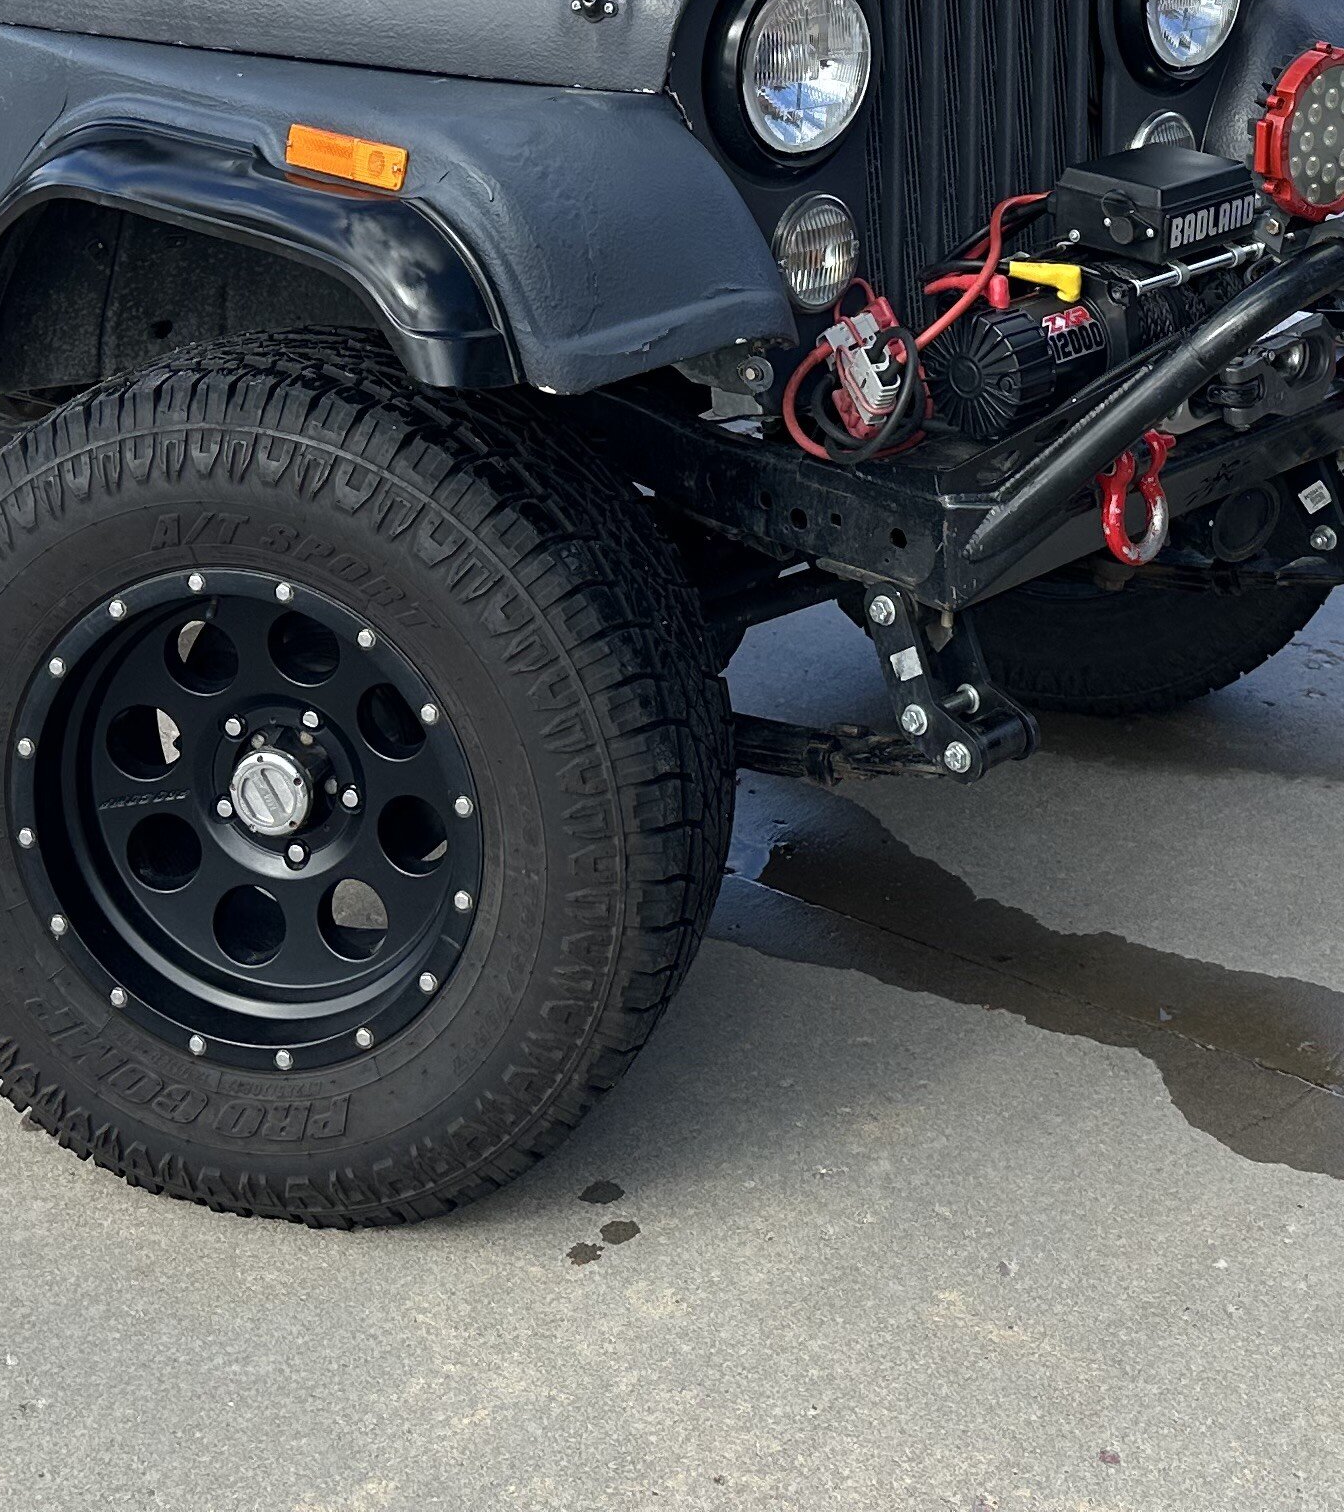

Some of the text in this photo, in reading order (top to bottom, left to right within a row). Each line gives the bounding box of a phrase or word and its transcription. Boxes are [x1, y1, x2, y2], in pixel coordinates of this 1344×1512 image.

[1170, 194, 1255, 249] BADLAND
[1049, 321, 1106, 364] 12000
[150, 511, 441, 629] A/T SPORT
[23, 996, 209, 1125] COMP
[213, 1093, 353, 1143] PRO
